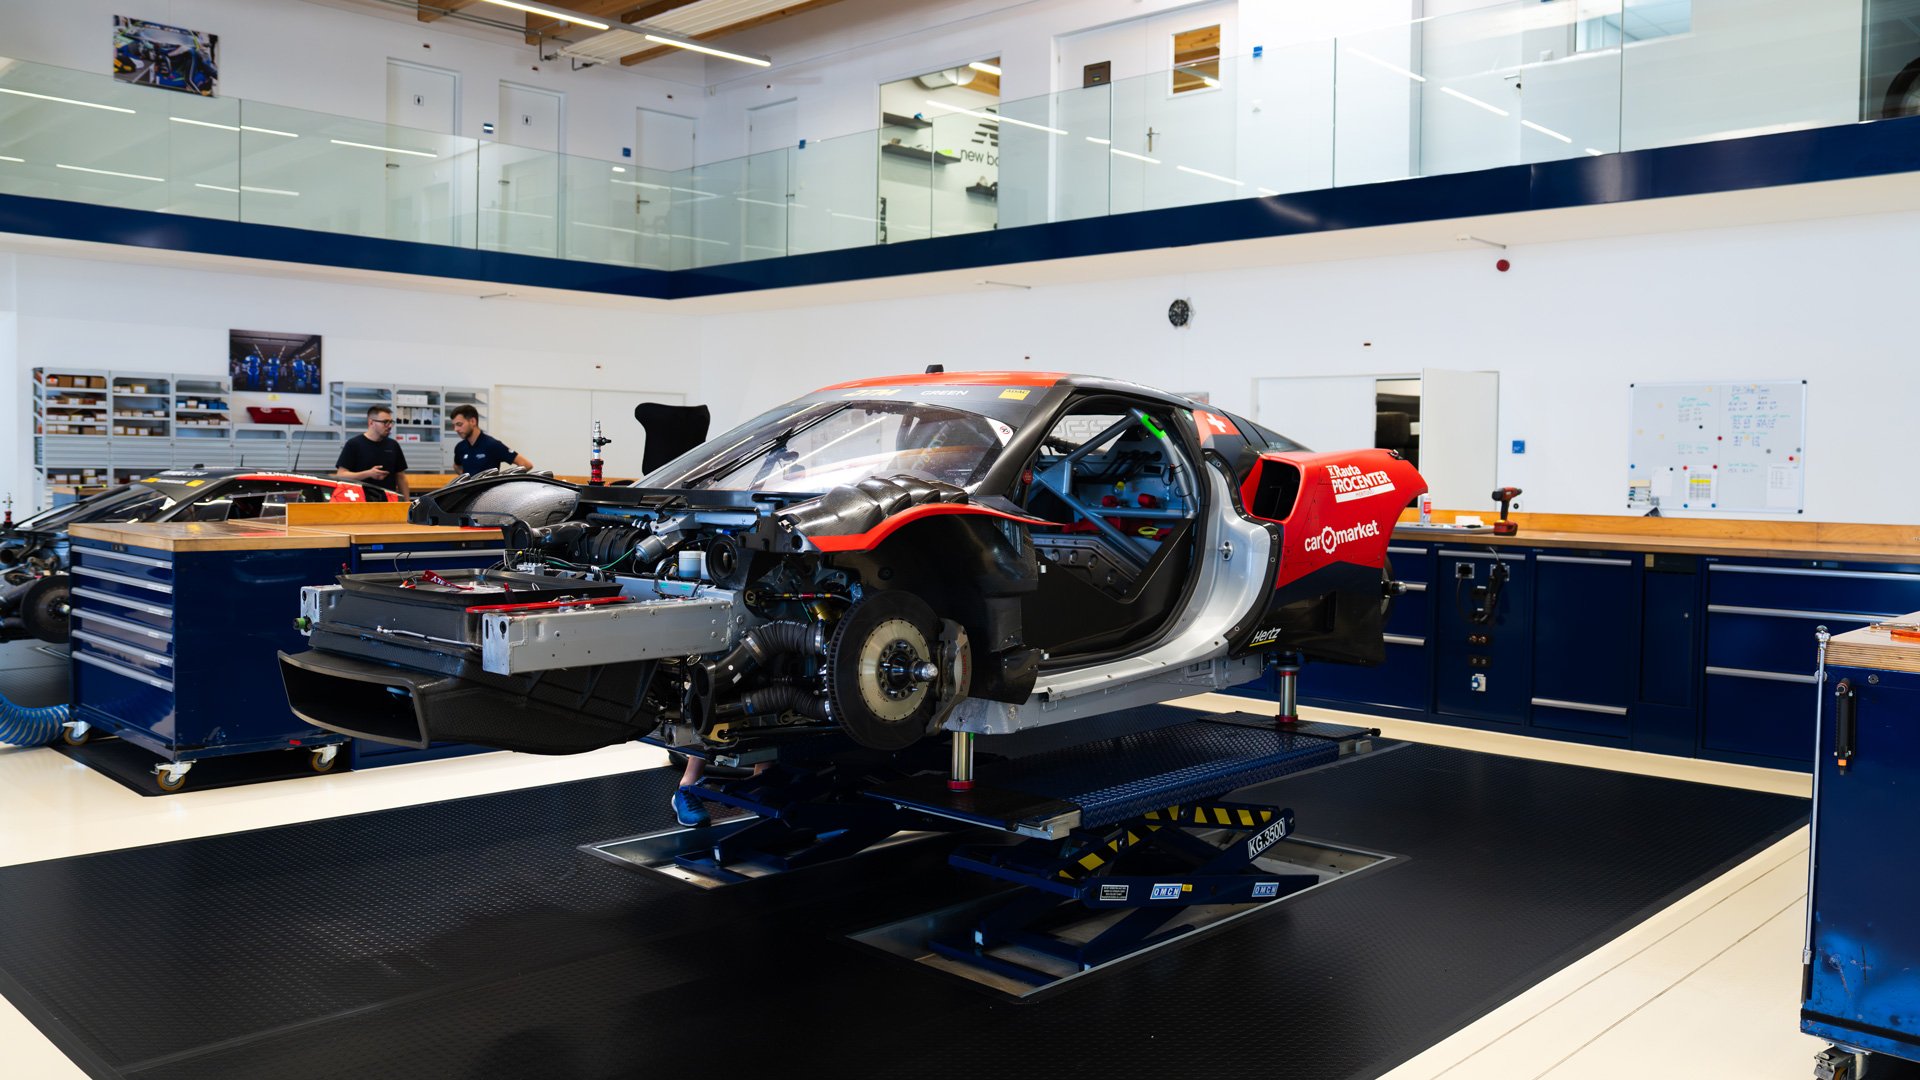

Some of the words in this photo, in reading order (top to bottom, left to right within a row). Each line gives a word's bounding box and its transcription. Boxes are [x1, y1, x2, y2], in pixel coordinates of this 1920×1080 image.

[961, 149, 984, 163] new
[1331, 470, 1392, 494] PROCENTER
[1251, 627, 1281, 644] Hertz
[1250, 820, 1284, 857] KG.3500
[1154, 887, 1179, 896] OMCN
